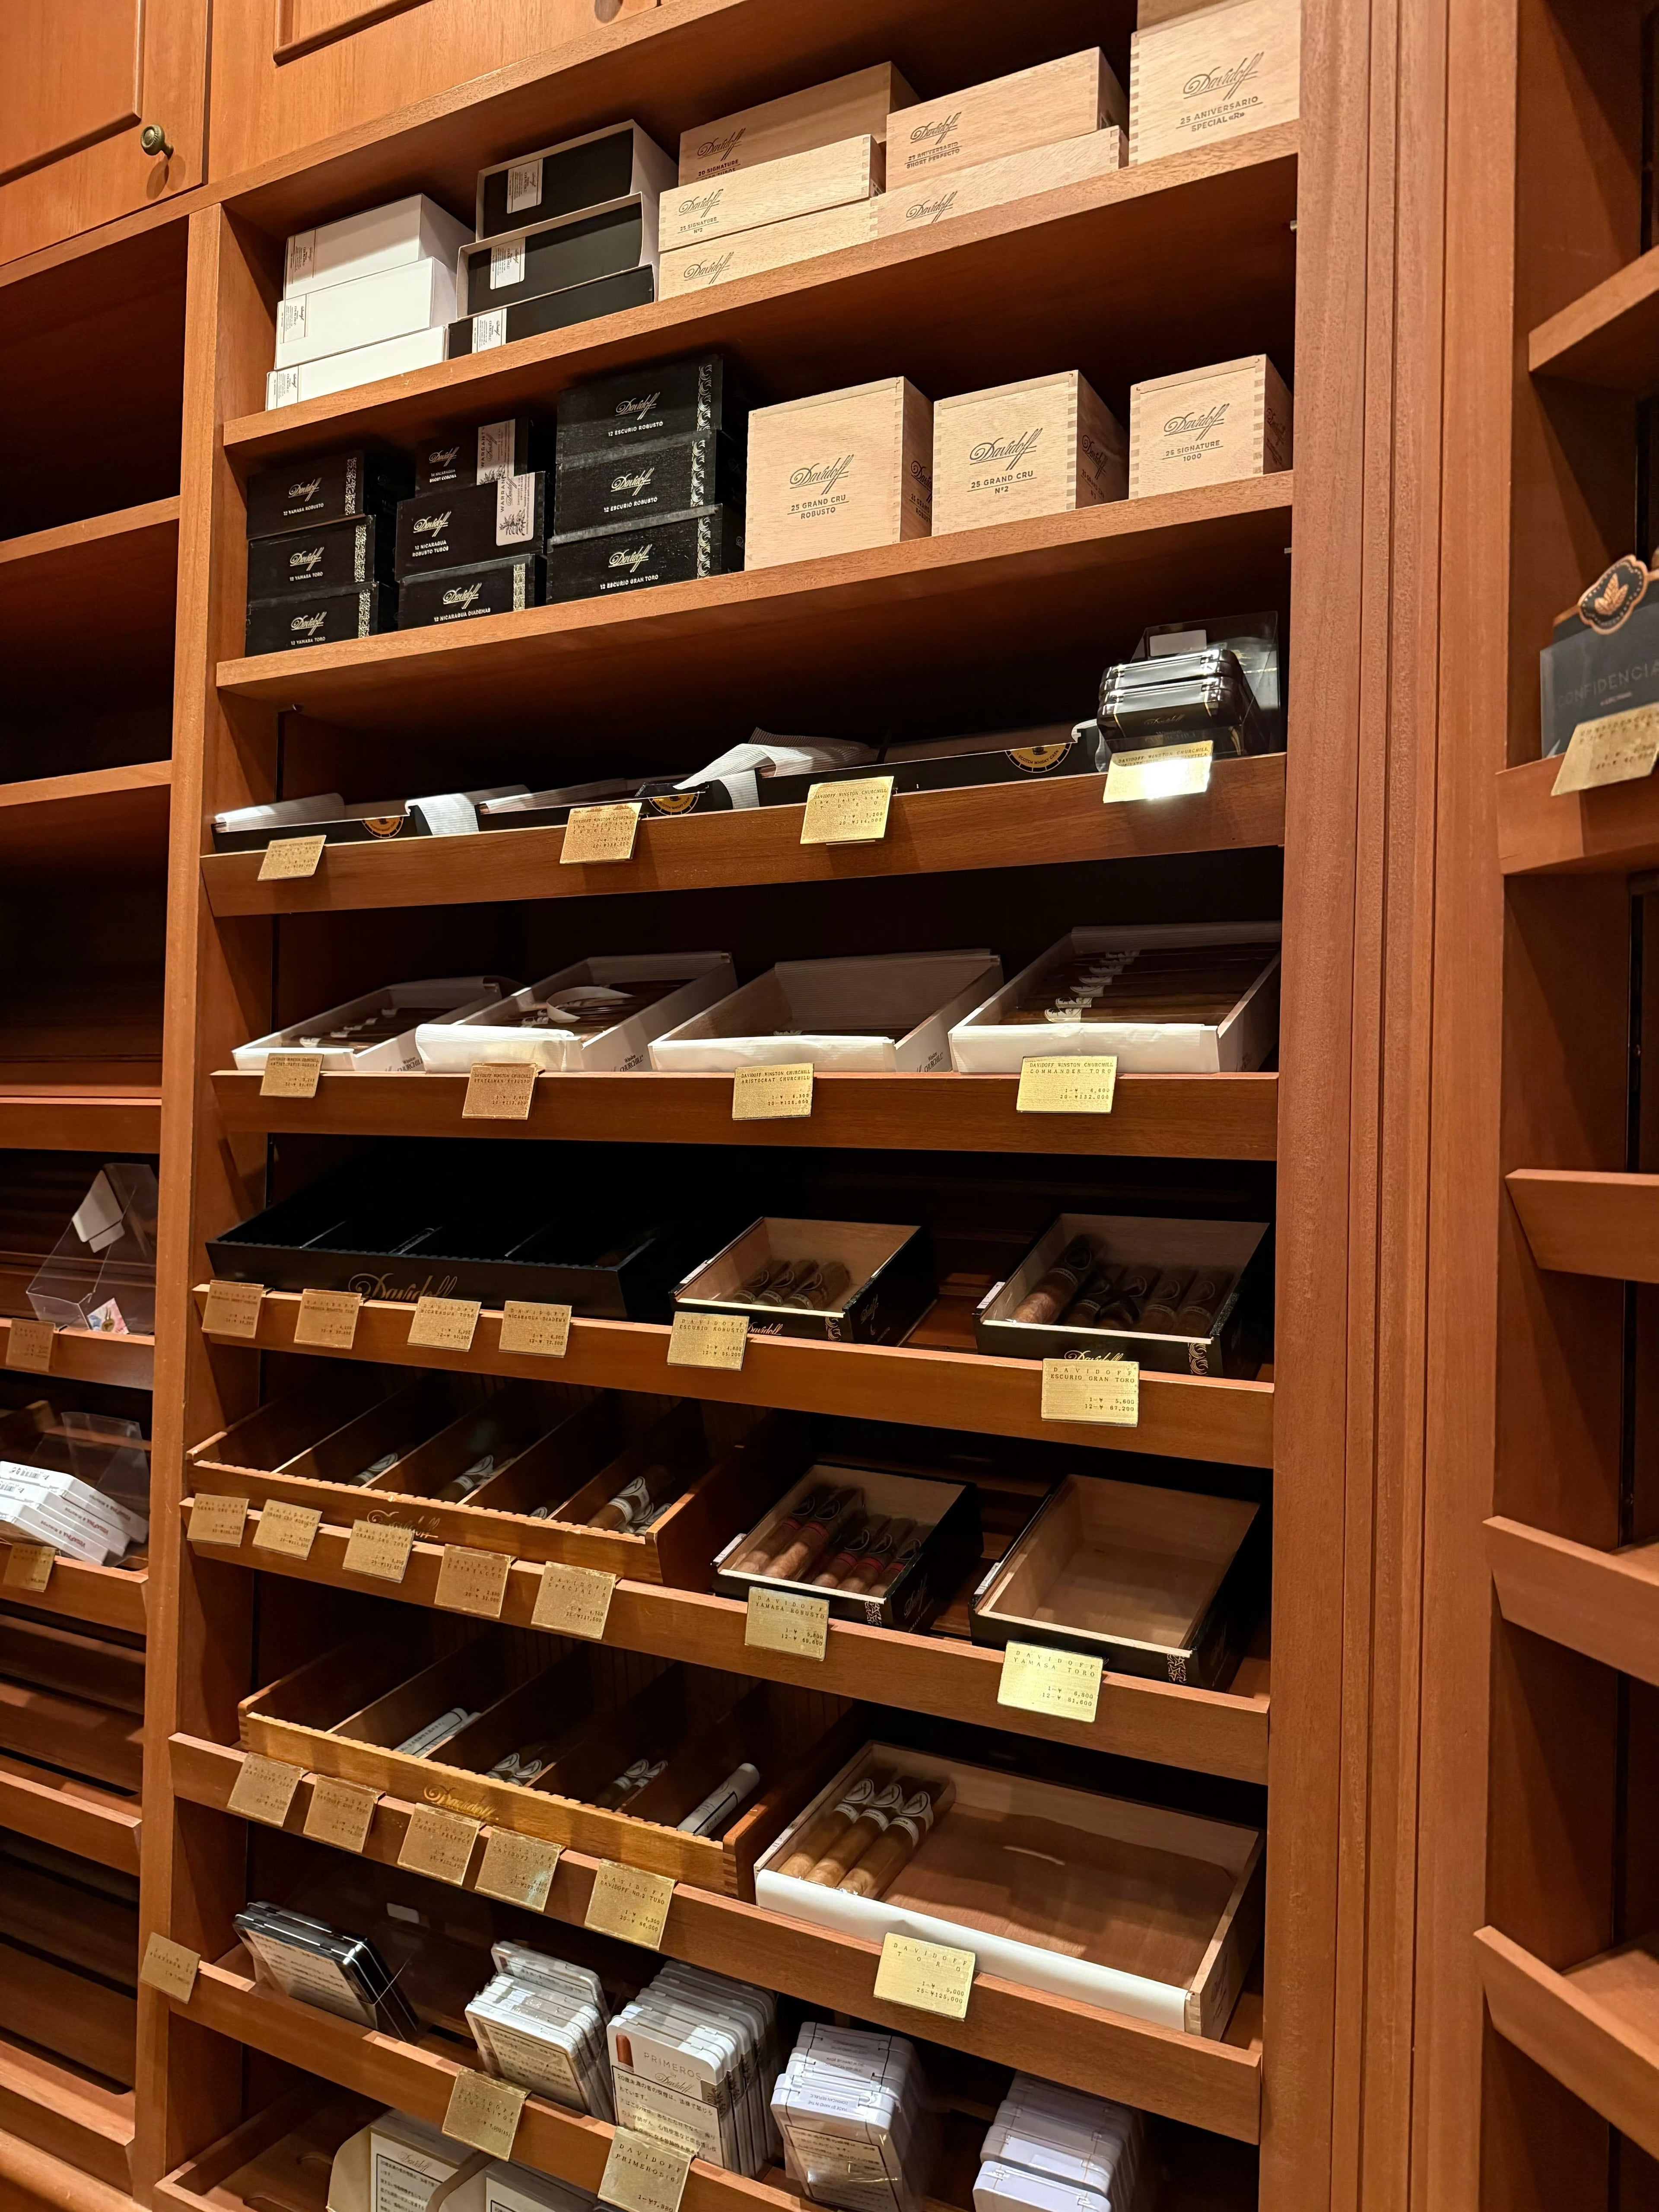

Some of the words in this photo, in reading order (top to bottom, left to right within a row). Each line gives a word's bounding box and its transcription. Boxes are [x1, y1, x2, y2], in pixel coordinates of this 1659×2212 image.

[1183, 52, 1264, 101] Davidoff
[1180, 116, 1191, 125] 25
[1194, 96, 1259, 120] ANIVERSARIO
[910, 111, 962, 145] Davidoff
[1192, 117, 1227, 132] SPECIAL
[697, 128, 746, 161] Davidoff
[917, 142, 958, 159] ANIVERSARIO
[928, 148, 960, 163] PERFECTO
[707, 159, 739, 174] SIGNATURE
[678, 188, 724, 218] Davidoff
[906, 191, 958, 223] Davidoff
[687, 217, 717, 229] SIGNATURE
[684, 251, 734, 284] Davidoff
[614, 391, 661, 420] Davidoff
[614, 426, 638, 436] ESCURIO
[638, 421, 664, 431] ROBUSTO
[1163, 403, 1230, 442] Davidoff
[429, 446, 460, 467] Davidoff
[969, 427, 1043, 471] Davidoff
[1177, 440, 1220, 455] SIGNATURE
[1183, 453, 1202, 462] 1000
[610, 467, 655, 497] Davidoff
[789, 454, 854, 496] Davidoff
[984, 475, 1013, 486] GRAND
[1017, 470, 1034, 480] CRU
[288, 477, 323, 502] Davidoff
[610, 502, 632, 512] ESCURIO
[633, 497, 658, 507] ROBUSTO
[802, 498, 828, 509] GRAND
[831, 494, 846, 503] CRU
[801, 506, 836, 520] ROBUSTO
[413, 511, 452, 538] Davidoff
[412, 549, 433, 558] ROBUSTO
[420, 539, 447, 550] NICARAGUA
[290, 546, 325, 572] Davidoff
[608, 544, 653, 573] Davidoff
[606, 579, 629, 589] ESCURIO
[630, 577, 645, 586] GRAN
[645, 574, 659, 582] TORO
[443, 582, 482, 610] Davidoff
[291, 611, 327, 636] Davidoff
[440, 611, 468, 621] NICARAGUA
[1018, 755, 1033, 764] SCOTCH
[1176, 747, 1208, 756] CHURCHILL
[348, 1272, 458, 1302] Davidoff
[682, 1319, 744, 1327] DAVIDOFF
[1054, 1367, 1132, 1376] DAVIDOFF
[548, 1582, 592, 1595] SPECIAL
[550, 1576, 607, 1590] DAVIDOFF
[755, 1602, 784, 1612] YAMASA
[790, 1608, 825, 1619] ROBUSTO
[757, 1595, 824, 1612] DAVIDOFF
[1014, 1657, 1056, 1670] YAMASA
[1068, 1667, 1095, 1677] TORO
[1016, 1650, 1095, 1670] DAVIDOFF
[600, 1880, 629, 1893] DAVIDOFF
[649, 1895, 665, 1905] TUBO
[604, 1874, 665, 1897] DAVIDOFF
[893, 1942, 968, 1967] DAVIDOFF
[897, 1951, 960, 1972] TORO
[644, 2052, 702, 2081] PRIMEROS
[655, 2073, 694, 2094] Davidoff
[619, 2143, 682, 2173] DAVIDOFF
